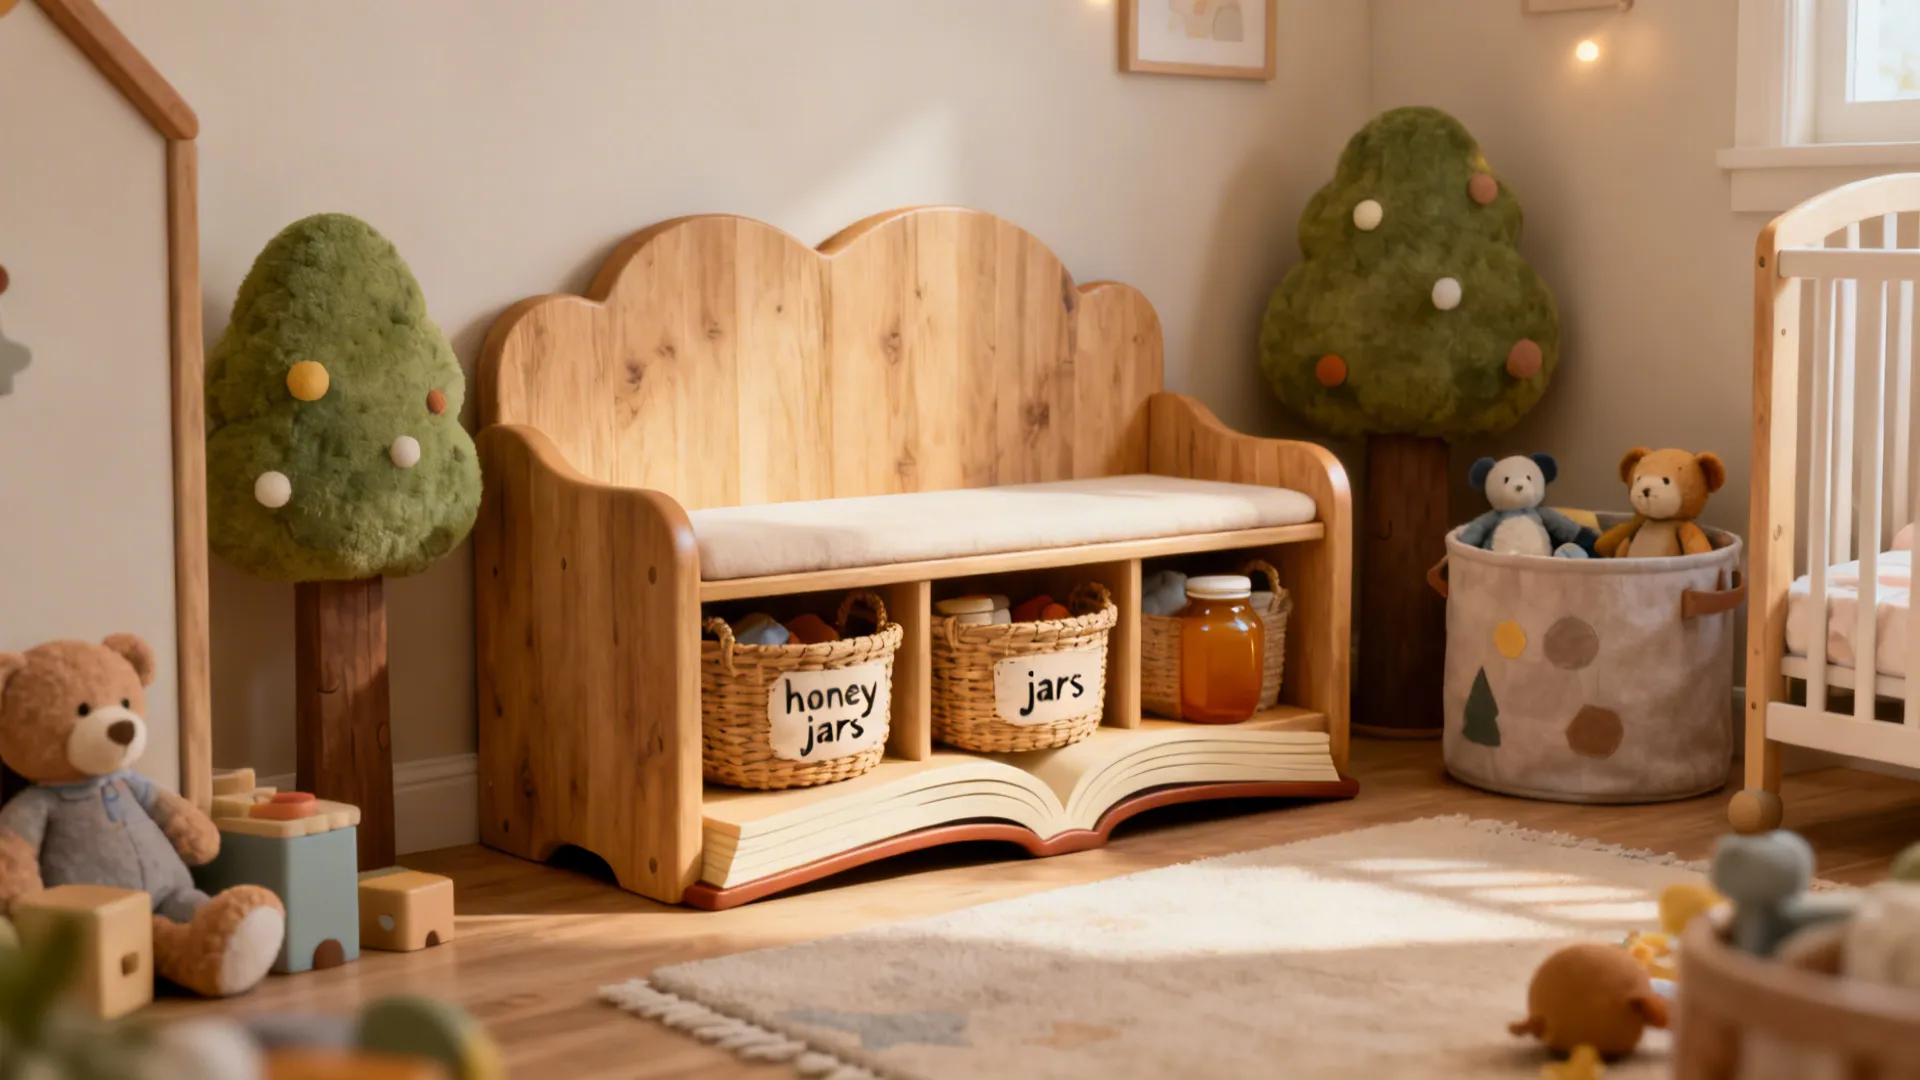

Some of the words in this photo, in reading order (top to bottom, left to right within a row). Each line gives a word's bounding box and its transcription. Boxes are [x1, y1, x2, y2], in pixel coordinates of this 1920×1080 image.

[784, 678, 878, 718] honey
[1019, 670, 1085, 717] jars
[800, 715, 865, 757] jars
